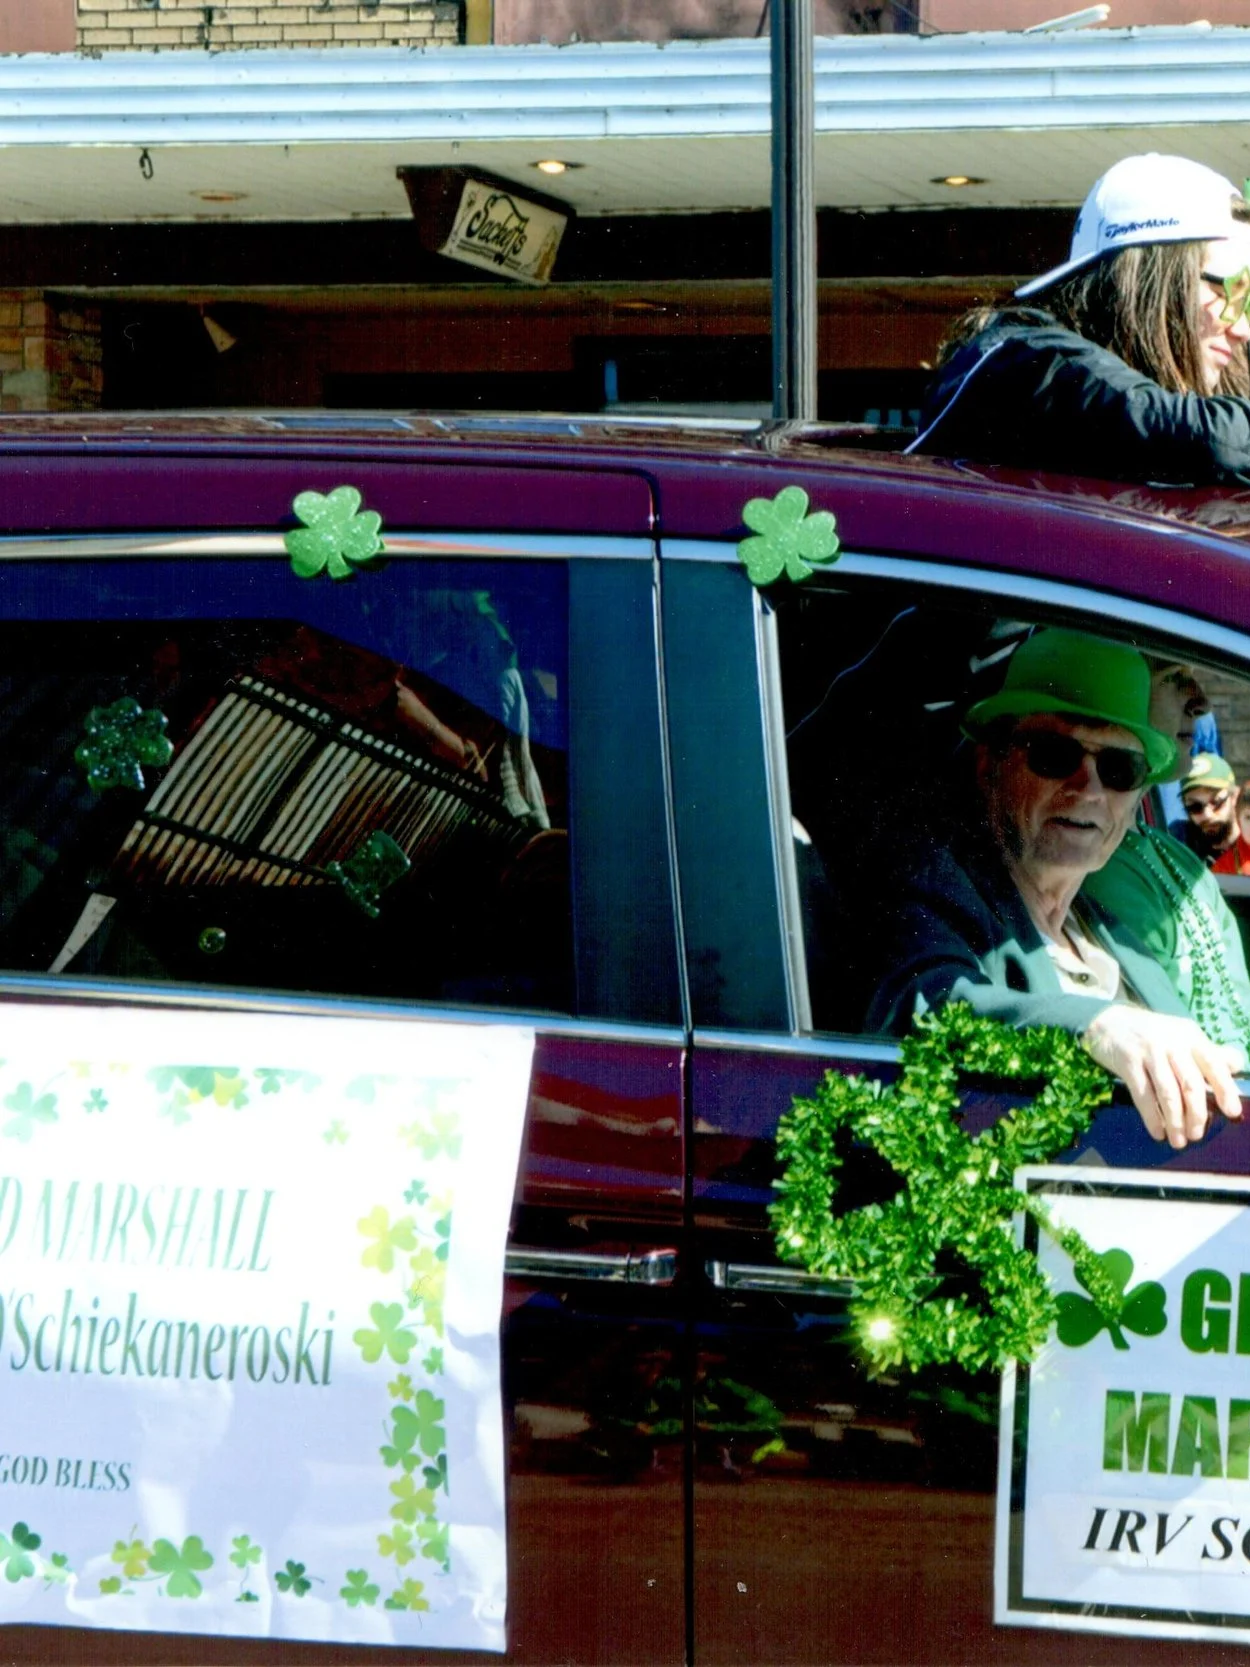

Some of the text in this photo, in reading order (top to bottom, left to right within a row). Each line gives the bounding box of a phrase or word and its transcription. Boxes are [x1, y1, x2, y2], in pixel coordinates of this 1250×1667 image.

[1105, 217, 1181, 239] TaylorMade
[29, 1179, 274, 1272] MARSHALL
[0, 1286, 336, 1386] 'Schiekaneroski
[54, 1458, 132, 1493] BLESS
[1081, 1508, 1193, 1555] IRV
